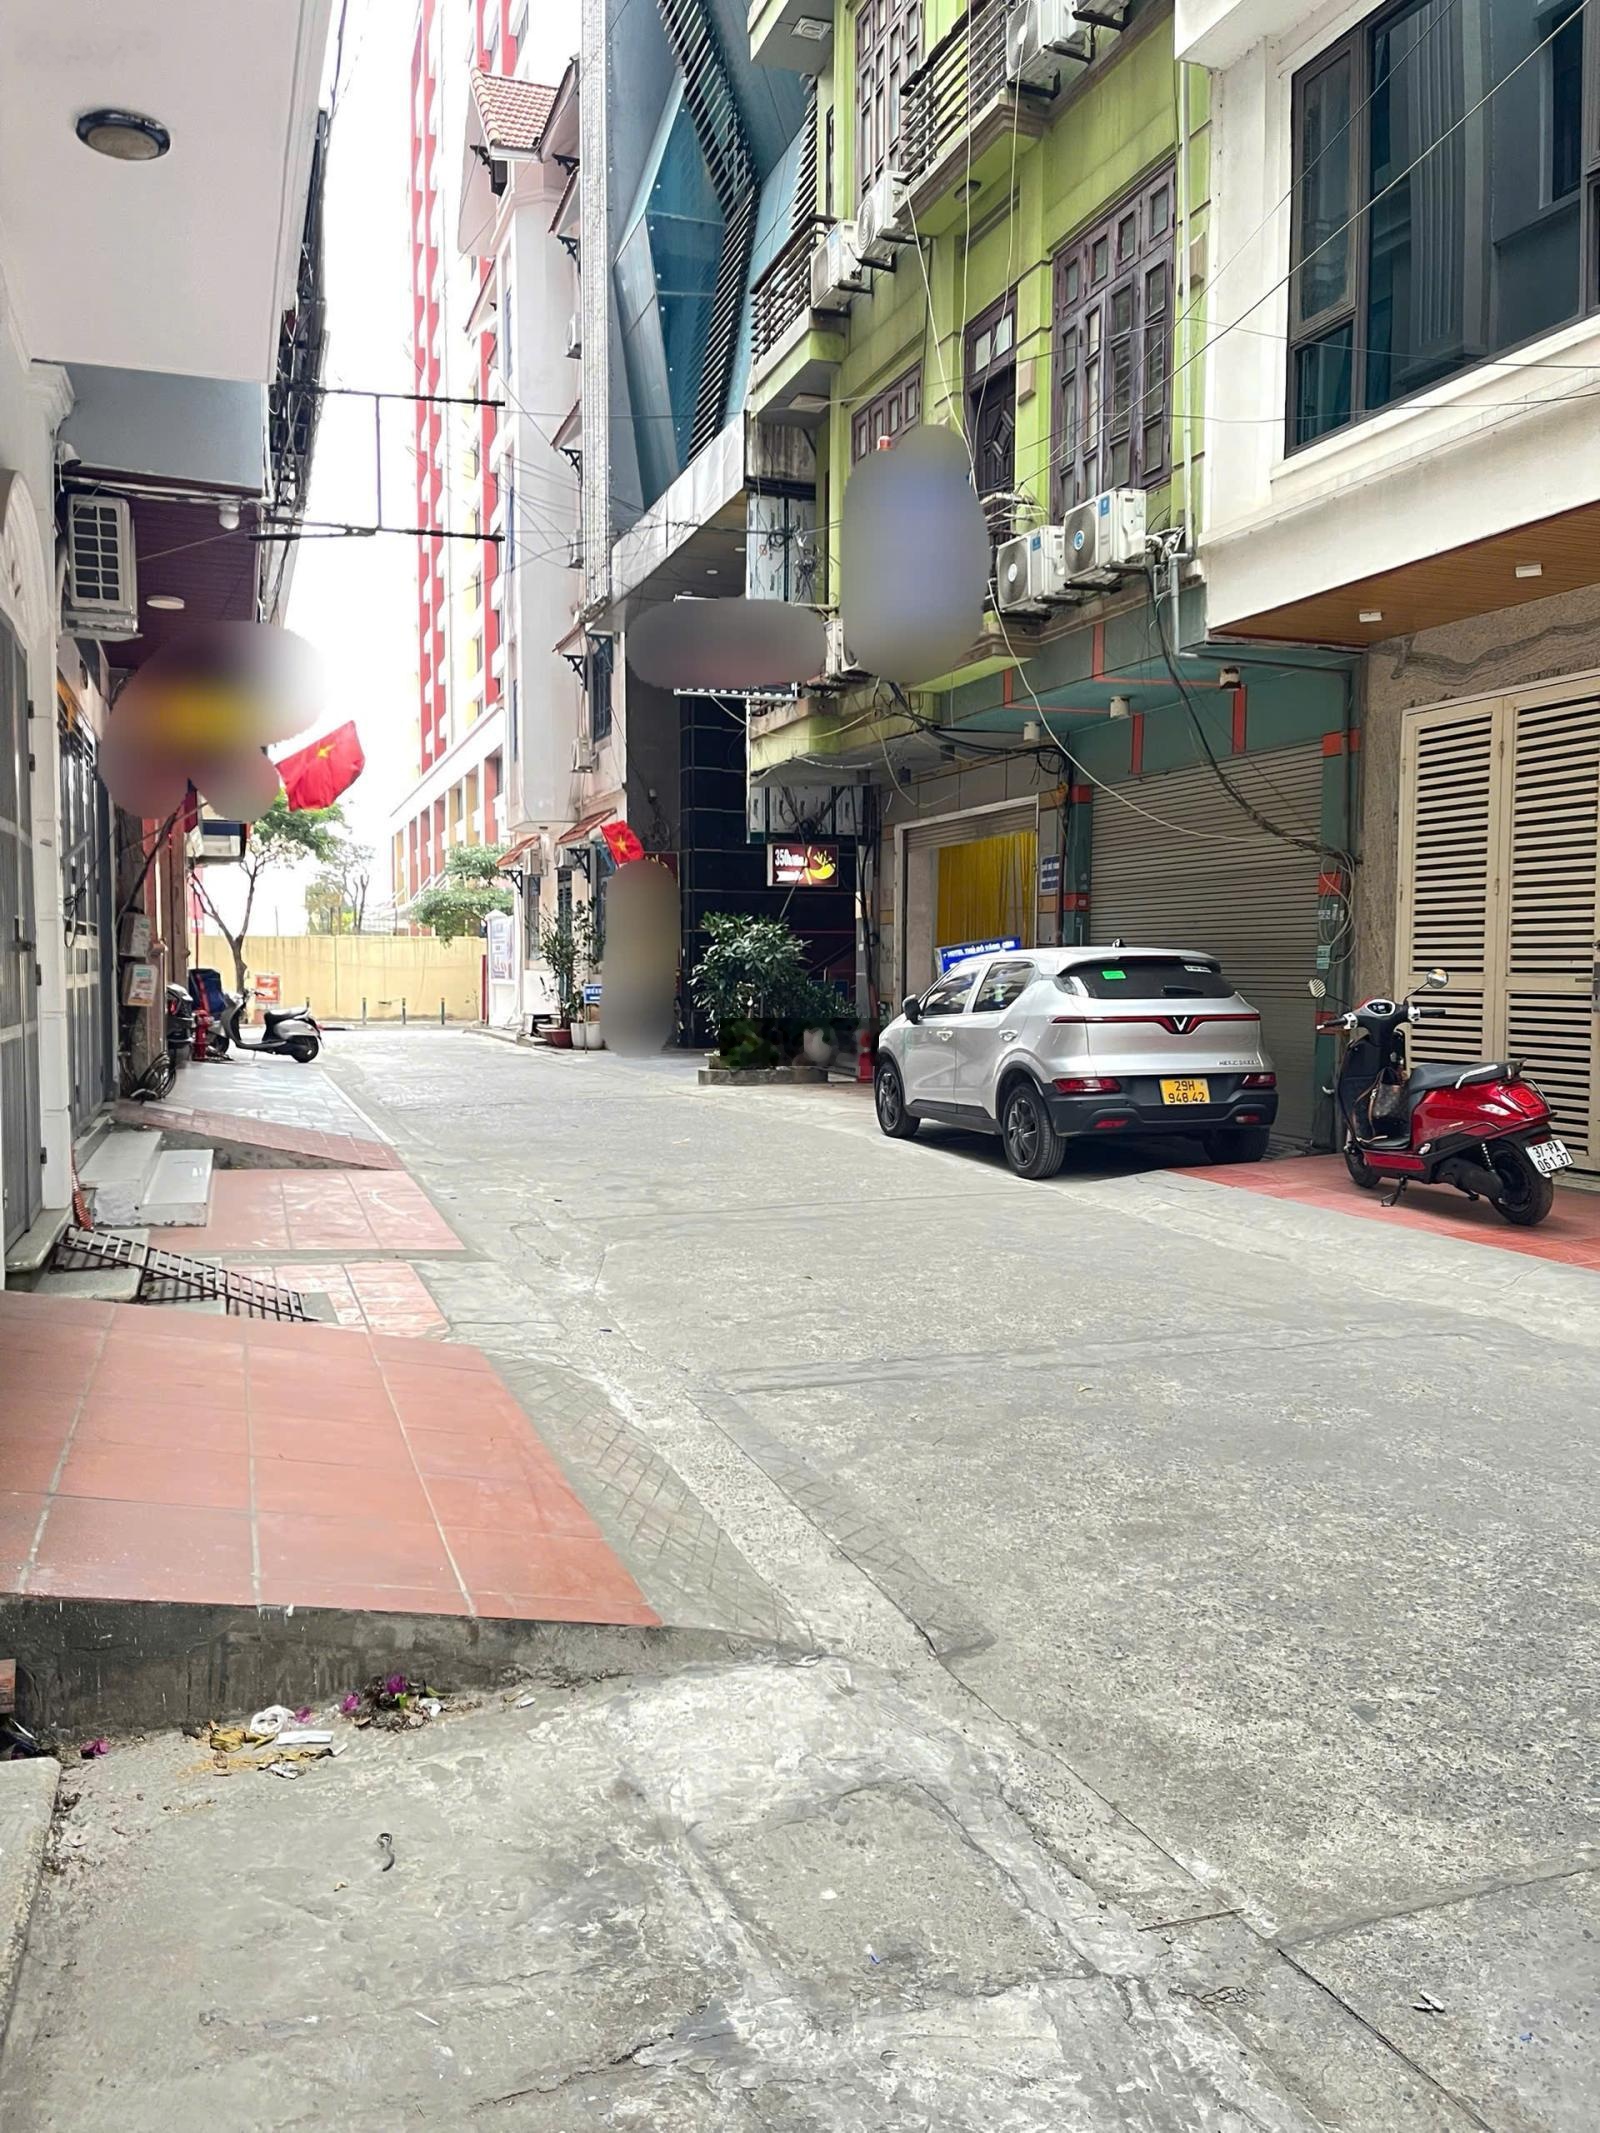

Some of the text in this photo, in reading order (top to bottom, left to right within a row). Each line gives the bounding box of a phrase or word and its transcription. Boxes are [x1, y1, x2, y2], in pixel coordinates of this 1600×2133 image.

[1174, 1080, 1195, 1091] 29H
[1168, 1092, 1206, 1103] 948.42
[1537, 1152, 1570, 1171] 061.37
